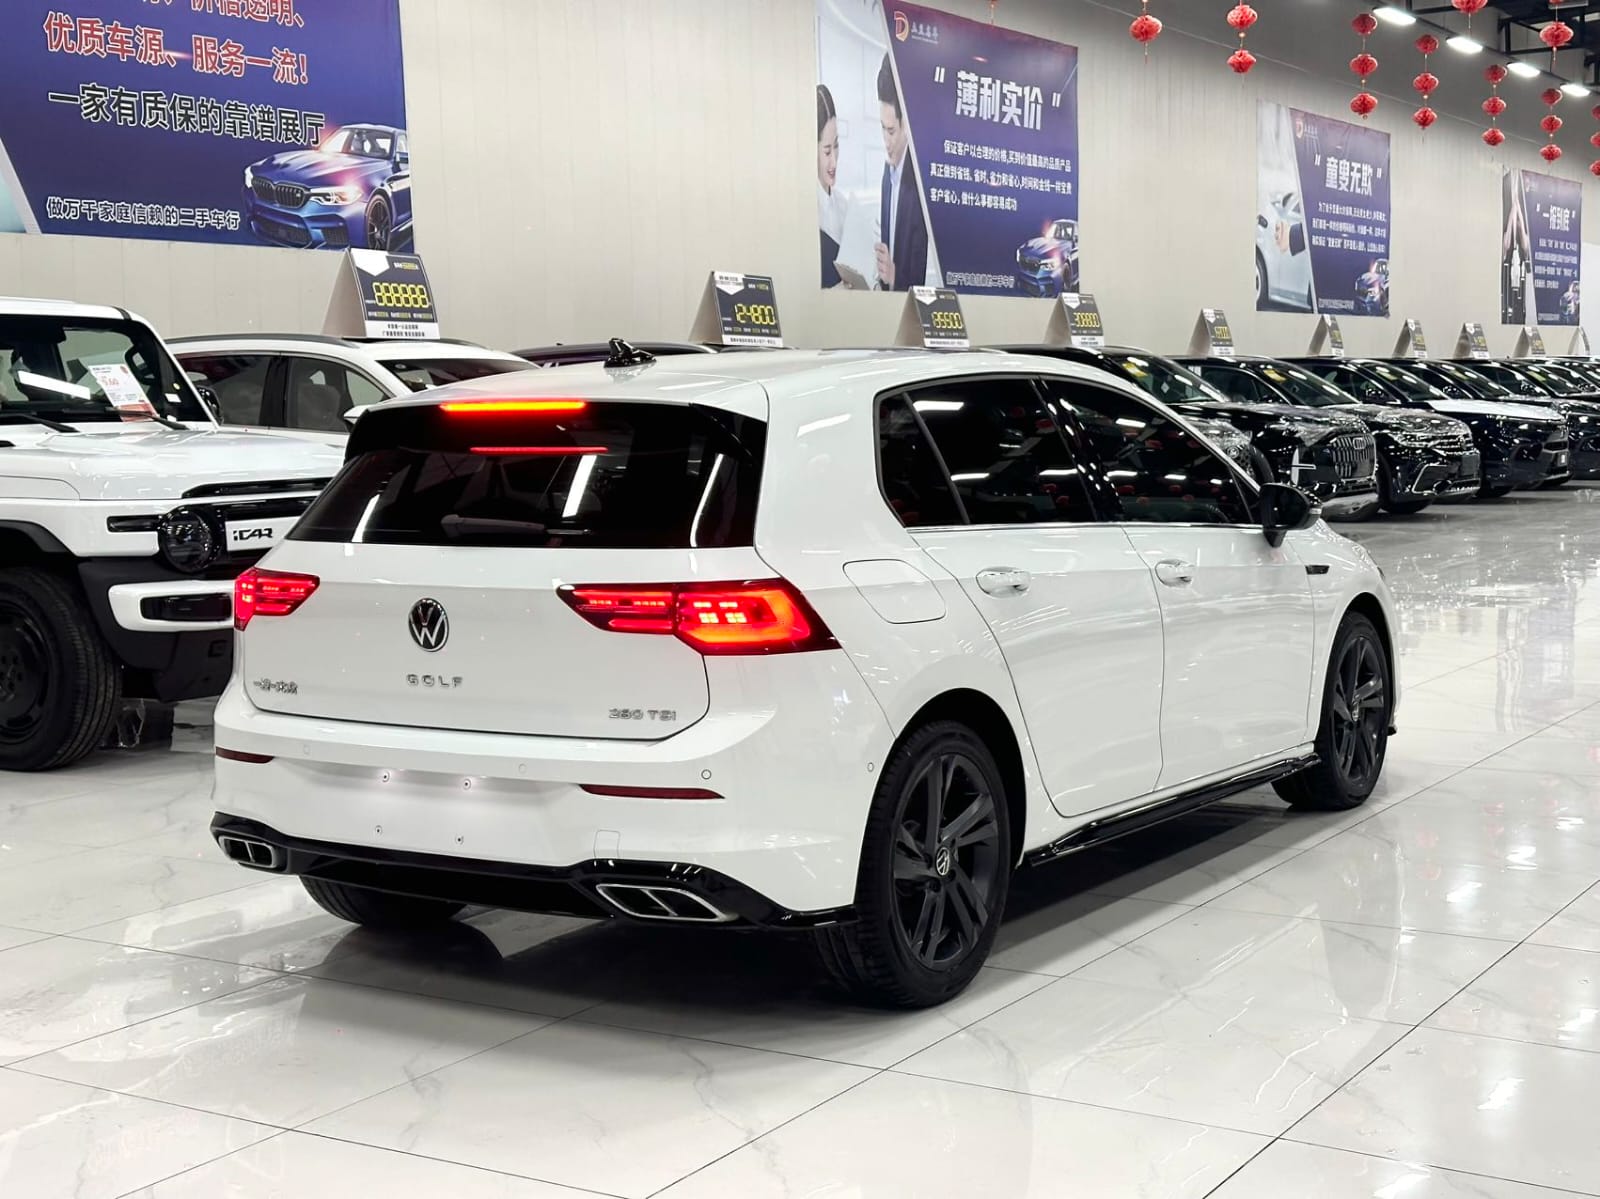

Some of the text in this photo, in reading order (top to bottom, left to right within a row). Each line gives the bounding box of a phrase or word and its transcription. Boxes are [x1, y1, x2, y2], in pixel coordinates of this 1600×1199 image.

[48, 83, 325, 146] 一家有质保的靠谱展厅
[46, 197, 240, 231] 做万千家庭信赖的二手车行
[372, 282, 430, 308] 888888
[406, 673, 464, 688] GOLF
